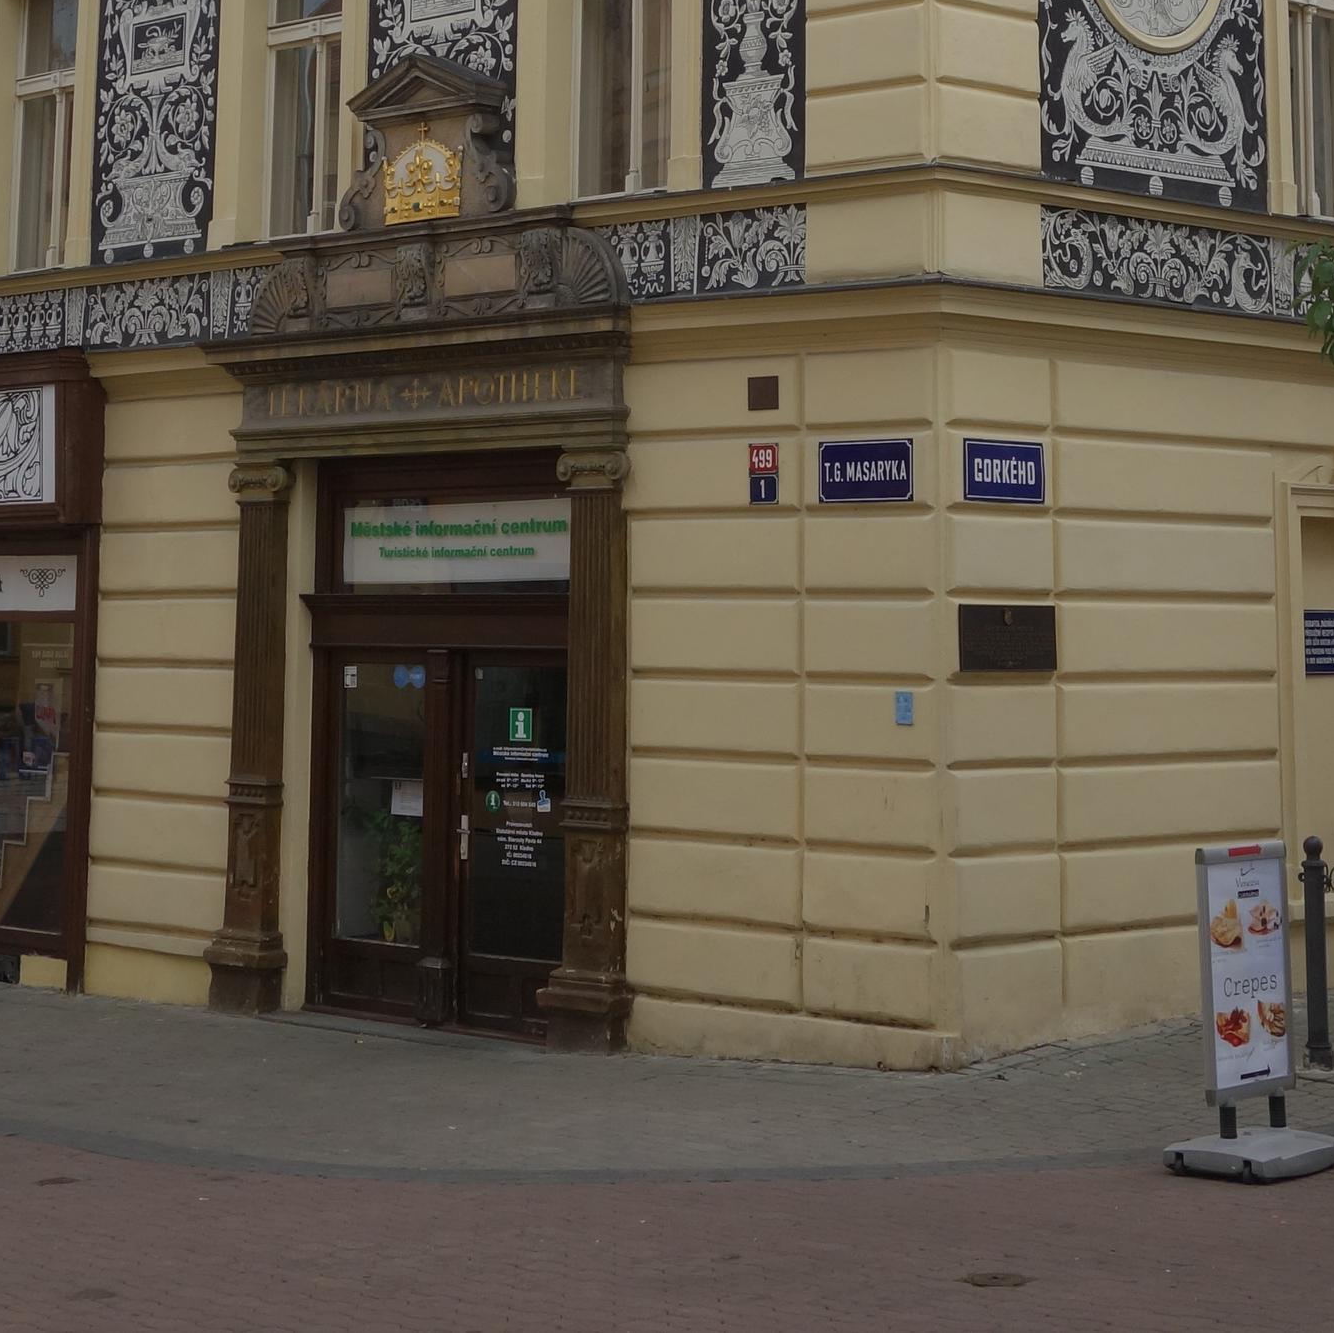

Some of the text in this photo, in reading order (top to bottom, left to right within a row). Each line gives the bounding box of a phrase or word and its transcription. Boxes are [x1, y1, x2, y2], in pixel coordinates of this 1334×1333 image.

[752, 449, 773, 469] 499
[846, 459, 907, 482] MASARYKA
[974, 456, 1036, 485] GORKÉHO
[760, 479, 766, 499] 1
[350, 517, 567, 537] Městské informační centrum
[378, 546, 535, 558] Turistické informační centrum
[1223, 974, 1278, 999] Crepes
